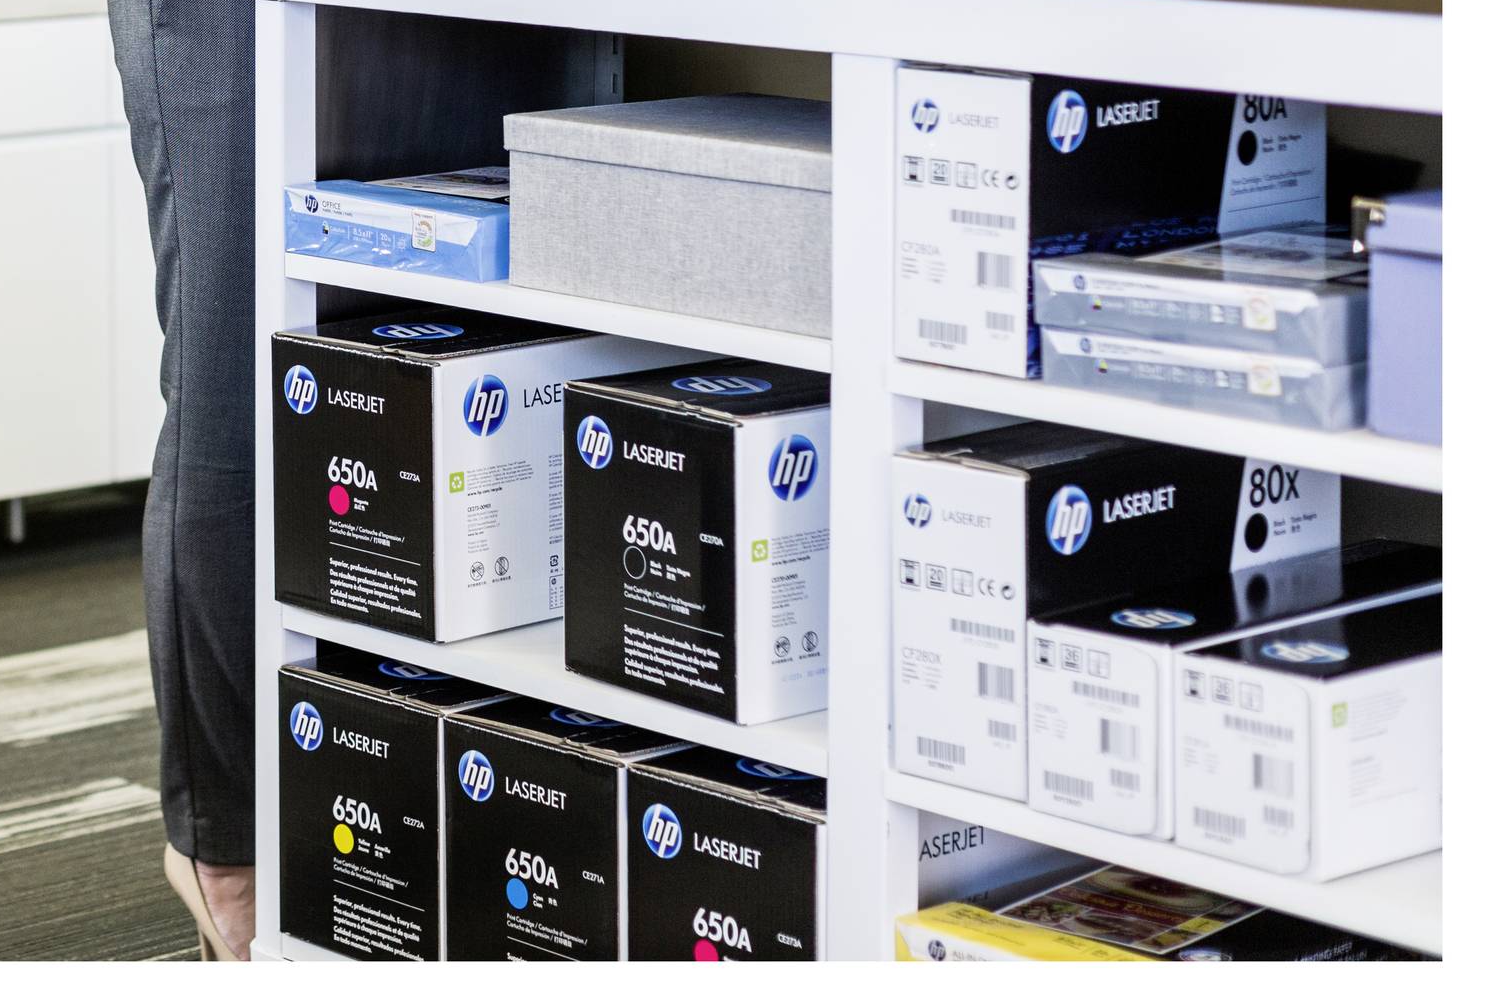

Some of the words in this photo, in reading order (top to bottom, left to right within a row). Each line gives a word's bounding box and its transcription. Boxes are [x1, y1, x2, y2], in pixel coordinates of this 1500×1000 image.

[948, 112, 999, 129] LASERJET
[1049, 89, 1085, 153] hp
[1097, 100, 1161, 128] LASERJET
[305, 195, 319, 213] hp
[322, 200, 341, 210] OFFICE
[382, 324, 458, 339] hp
[287, 365, 316, 414] hp
[328, 387, 385, 414] LASERJET
[467, 375, 505, 437] hp
[684, 376, 764, 395] hp
[580, 415, 611, 469] hp
[623, 441, 685, 472] LASERJET
[328, 456, 378, 491] 650A
[399, 470, 421, 483] CE273A
[771, 434, 815, 501] hp
[904, 493, 932, 529] hp
[941, 509, 992, 529] LASERJET
[1050, 484, 1090, 556] hp
[1103, 485, 1177, 524] LASERJET
[622, 514, 677, 555] 650A
[292, 702, 322, 751] hp
[333, 726, 389, 758] LASERJET
[461, 750, 493, 801] hp
[505, 776, 567, 810] LASERJET
[332, 794, 382, 834] 650A
[403, 816, 425, 829] CE272A
[646, 803, 680, 859] hp
[694, 831, 762, 870] LASERJET
[919, 825, 984, 861] ASERJET
[505, 848, 559, 890] 650A
[582, 870, 605, 884] CE271A
[693, 907, 752, 952] 650A
